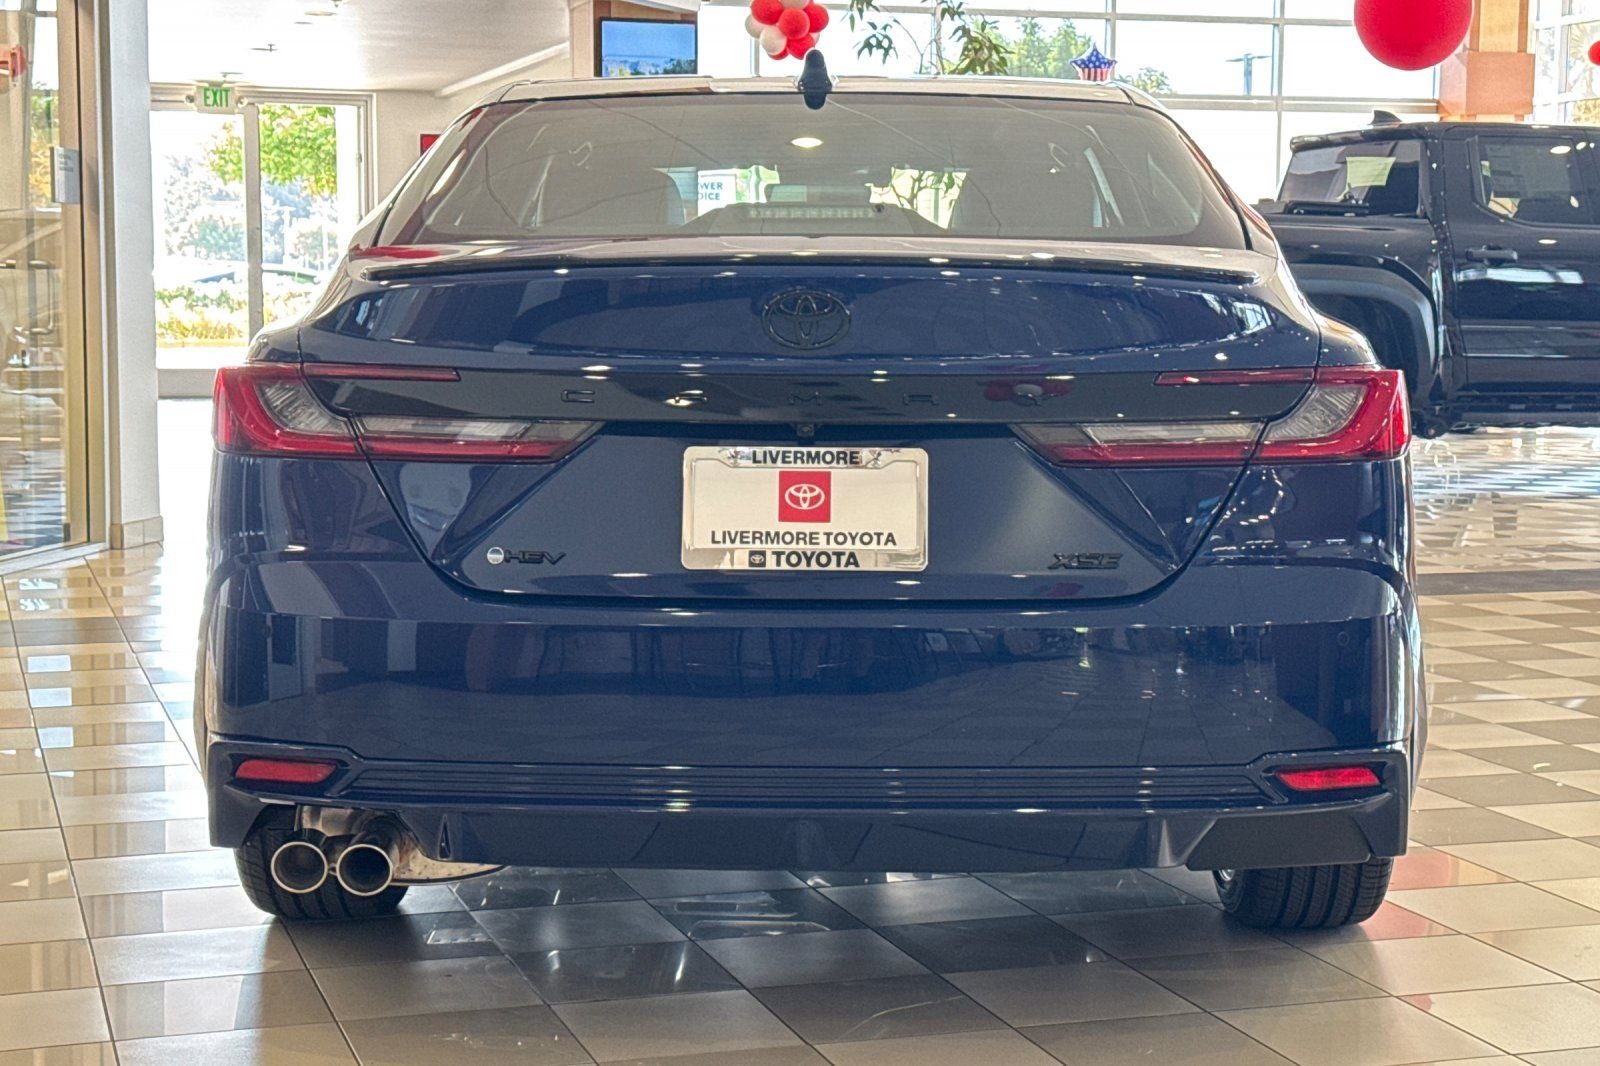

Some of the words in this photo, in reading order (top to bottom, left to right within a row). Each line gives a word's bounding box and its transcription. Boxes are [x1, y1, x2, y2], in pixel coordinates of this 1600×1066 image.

[203, 87, 231, 107] EXIT
[752, 450, 861, 465] LIVERMORE
[711, 530, 820, 546] LIVERMORE
[823, 531, 897, 546] TOYOTA
[504, 550, 567, 565] HEV
[772, 550, 860, 568] TOYOTA
[1047, 552, 1123, 570] XSE
